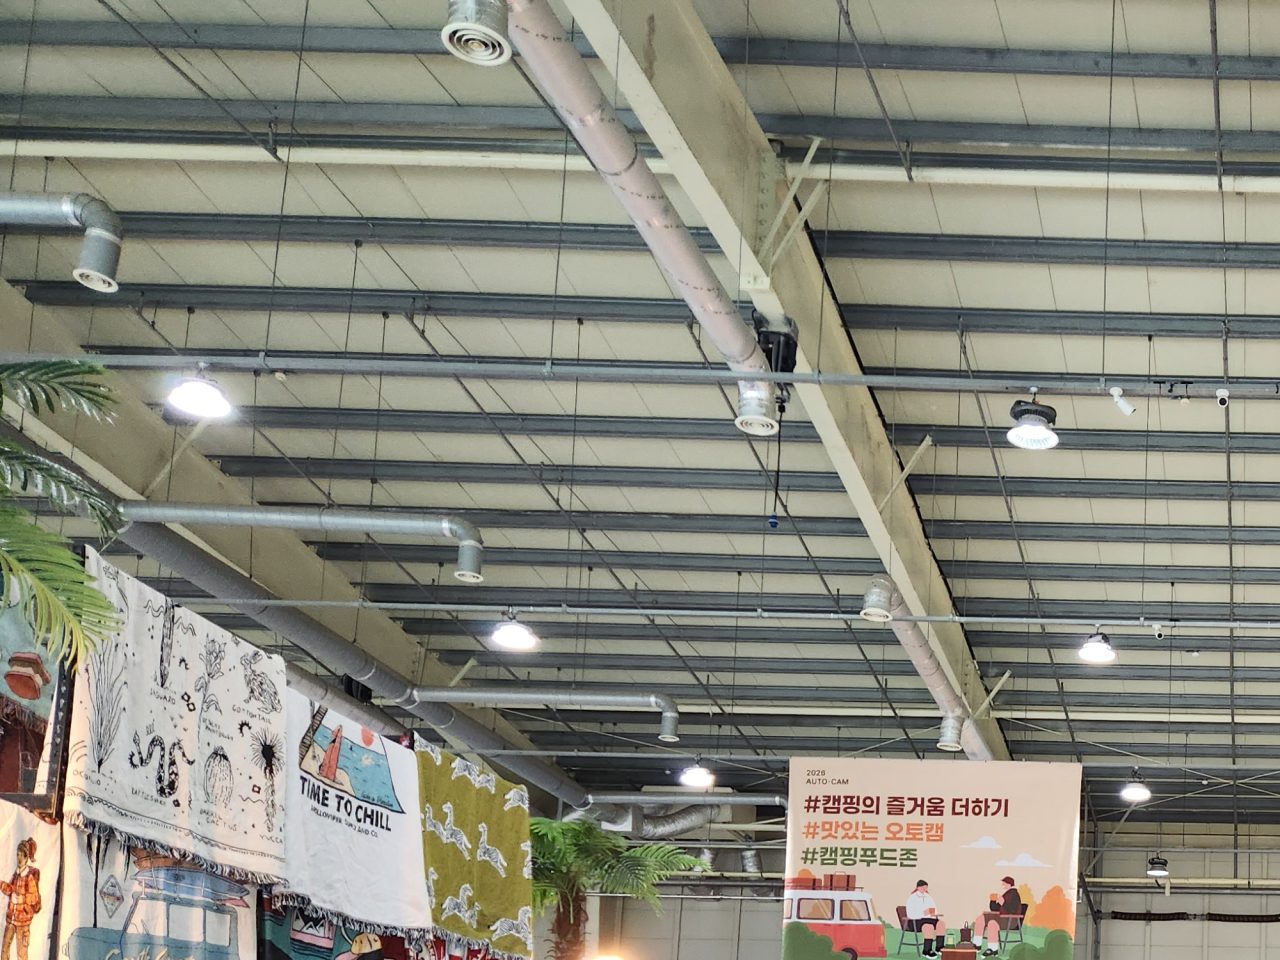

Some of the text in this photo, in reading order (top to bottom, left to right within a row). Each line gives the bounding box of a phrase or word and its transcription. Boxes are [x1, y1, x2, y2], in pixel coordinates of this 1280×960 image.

[300, 775, 330, 808] TIME
[335, 793, 353, 817] TO
[354, 805, 392, 832] CHILL
[803, 795, 1010, 818] #캠핑의 즐거움 더하기
[801, 820, 945, 843] #맛있는 오토캠
[800, 846, 919, 868] #캠핑푸드존
